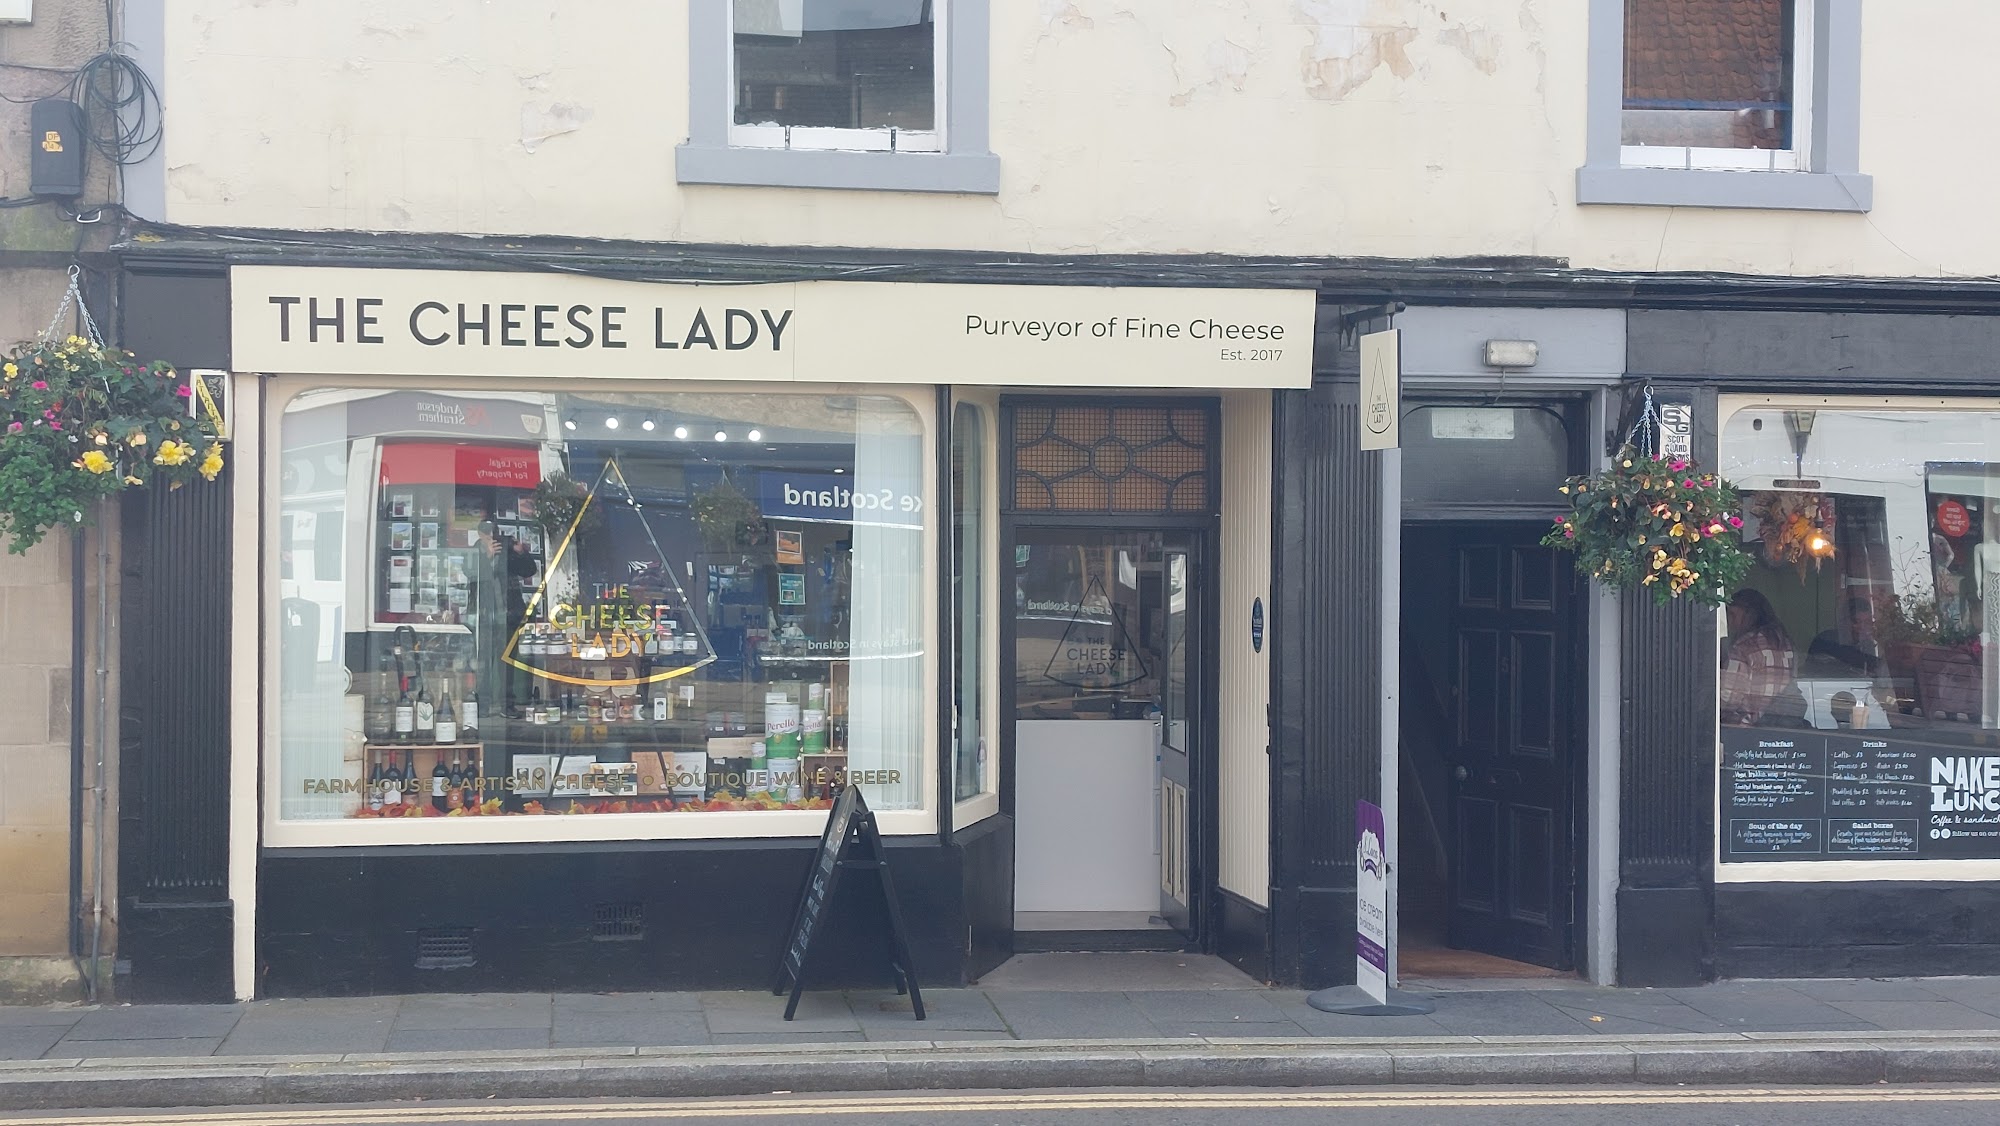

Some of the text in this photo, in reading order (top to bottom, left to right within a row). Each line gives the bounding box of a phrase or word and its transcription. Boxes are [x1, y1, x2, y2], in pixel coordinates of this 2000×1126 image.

[268, 296, 793, 352] THE CHEESE LADY
[965, 315, 1285, 341] Purveyor of Fine Cheese
[1220, 348, 1284, 362] Est. 2017
[1372, 402, 1386, 414] CHEESE
[1373, 414, 1384, 424] LADY
[1668, 436, 1684, 444] SCOT
[1665, 444, 1688, 452] GUARD
[592, 582, 630, 599] THE
[550, 604, 671, 630] CHEESE
[572, 632, 652, 658] LADY
[1088, 637, 1104, 645] THE
[1067, 648, 1126, 661] CHEESE
[1077, 662, 1116, 675] LADY
[303, 778, 434, 794] FARMHOUSE
[440, 777, 452, 792] &
[460, 776, 546, 791] ARTISAN
[552, 774, 630, 790] CHEESE
[666, 772, 768, 788] BOUTIQUE
[774, 772, 827, 786] WINE
[834, 770, 845, 785] &
[850, 770, 901, 785] BEER
[1931, 814, 1953, 826] Coffee
[1954, 814, 1962, 824] &
[1368, 904, 1384, 922] cream
